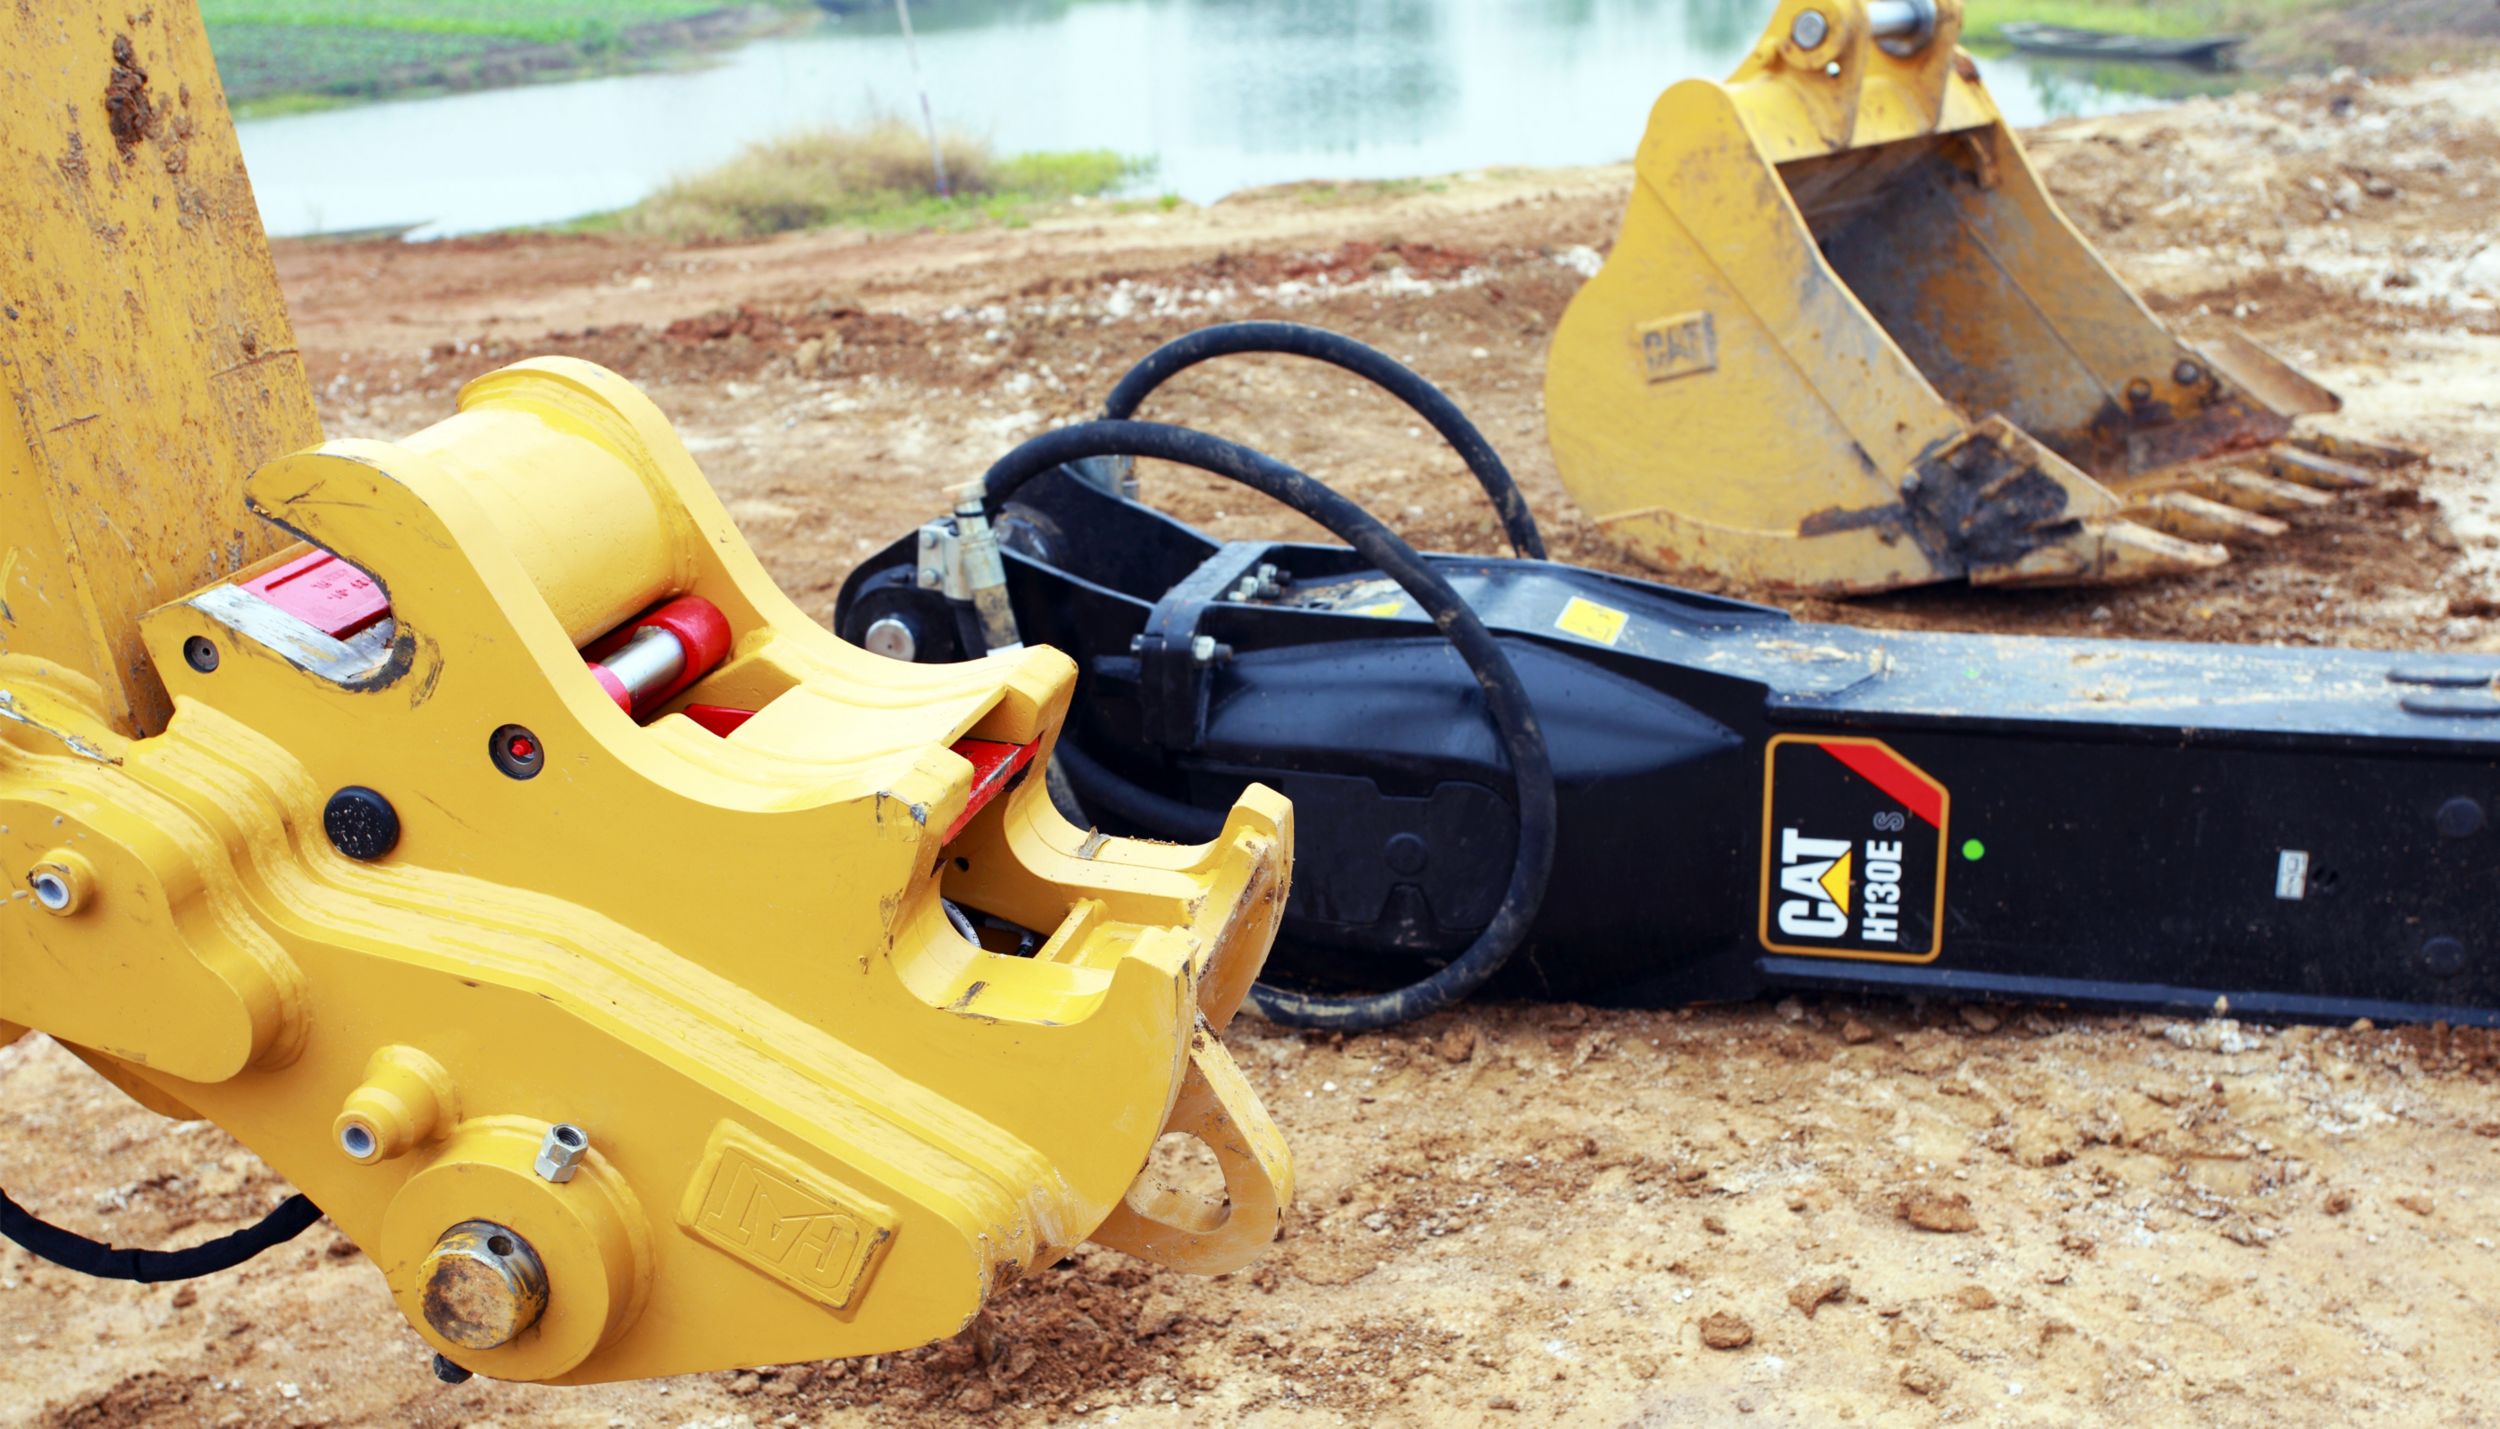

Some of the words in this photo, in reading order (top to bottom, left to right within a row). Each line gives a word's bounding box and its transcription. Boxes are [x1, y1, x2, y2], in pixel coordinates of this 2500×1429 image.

[1642, 319, 1704, 371] CAT
[1778, 827, 1851, 938] CAT
[1862, 839, 1903, 942] H130E
[703, 1161, 859, 1289] CAT
